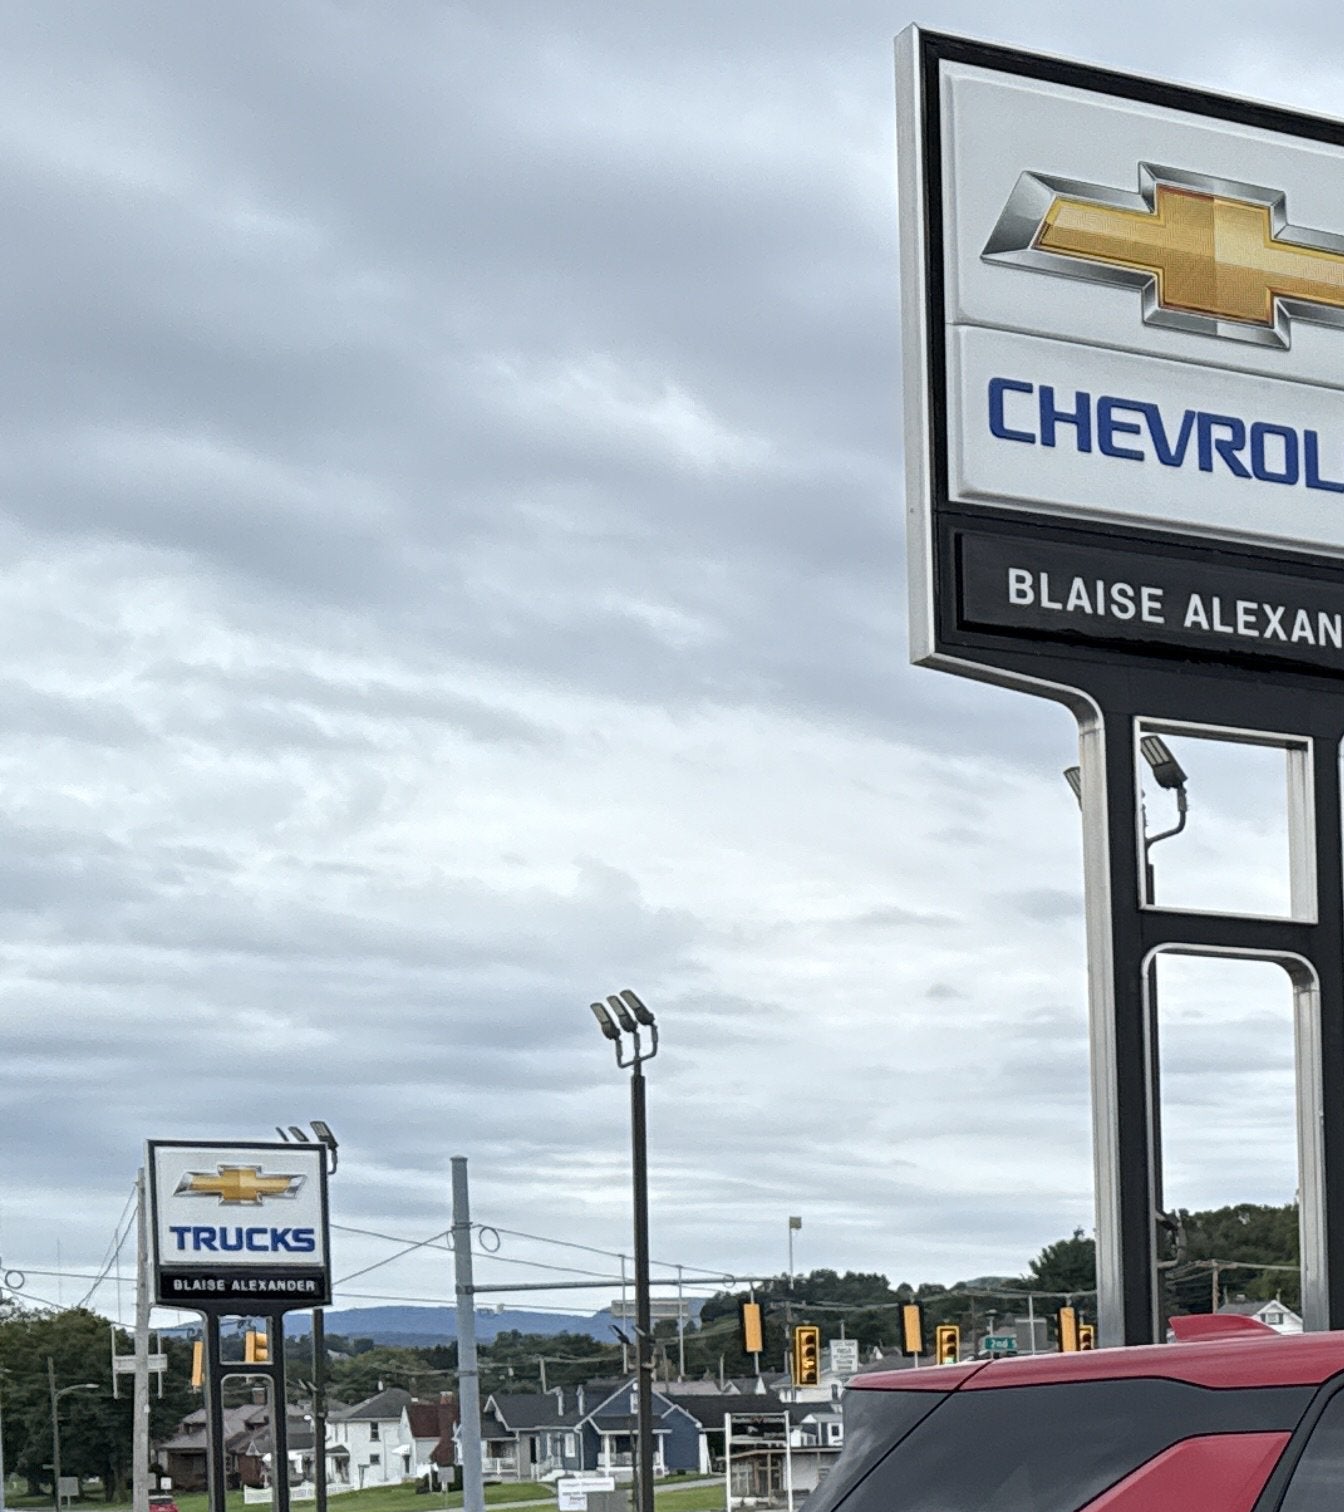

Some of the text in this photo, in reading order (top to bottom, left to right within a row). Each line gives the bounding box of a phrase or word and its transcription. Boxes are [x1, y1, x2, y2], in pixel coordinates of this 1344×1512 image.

[1008, 568, 1165, 624] BLAISE
[169, 1226, 315, 1252] TRUCKS
[173, 1279, 315, 1291] BLAISE ALEXANDER
